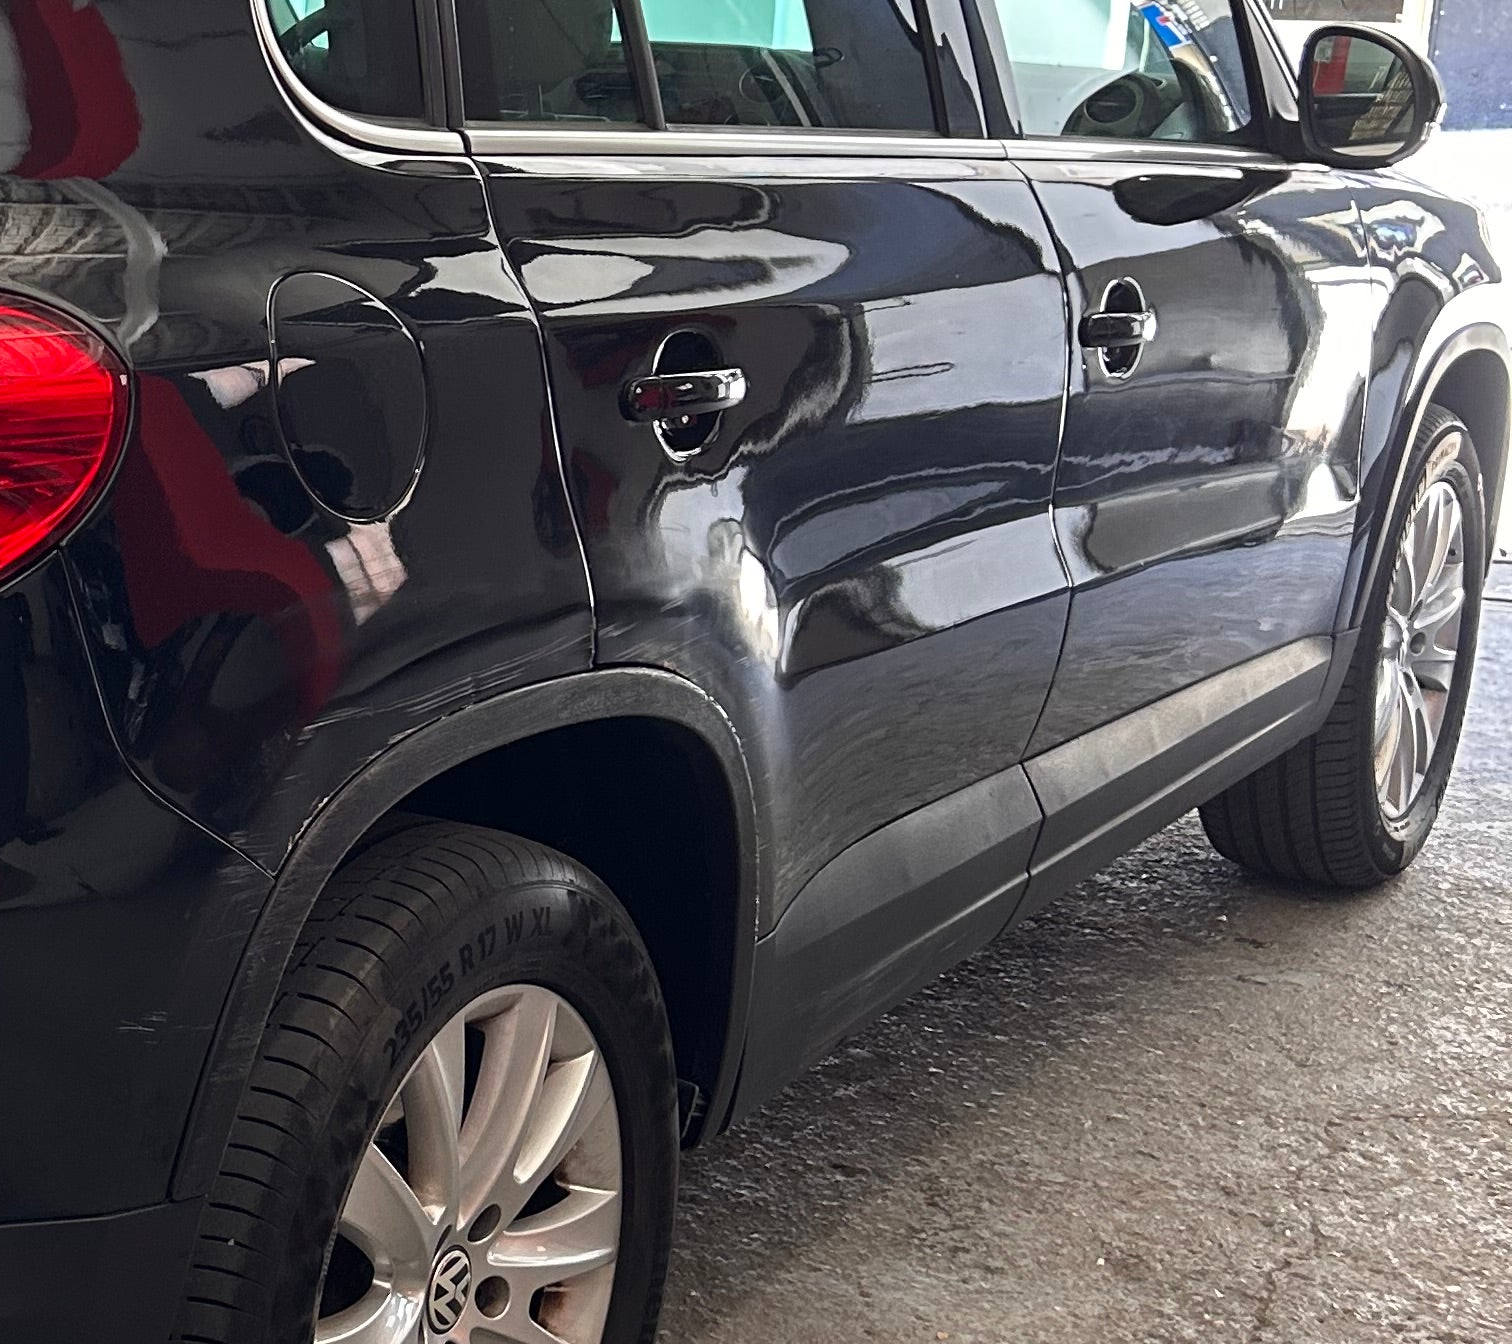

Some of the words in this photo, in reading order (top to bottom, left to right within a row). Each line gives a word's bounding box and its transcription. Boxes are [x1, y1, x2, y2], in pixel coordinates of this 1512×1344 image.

[383, 960, 456, 1068] 235/55
[459, 943, 475, 977] R
[504, 910, 524, 945] W
